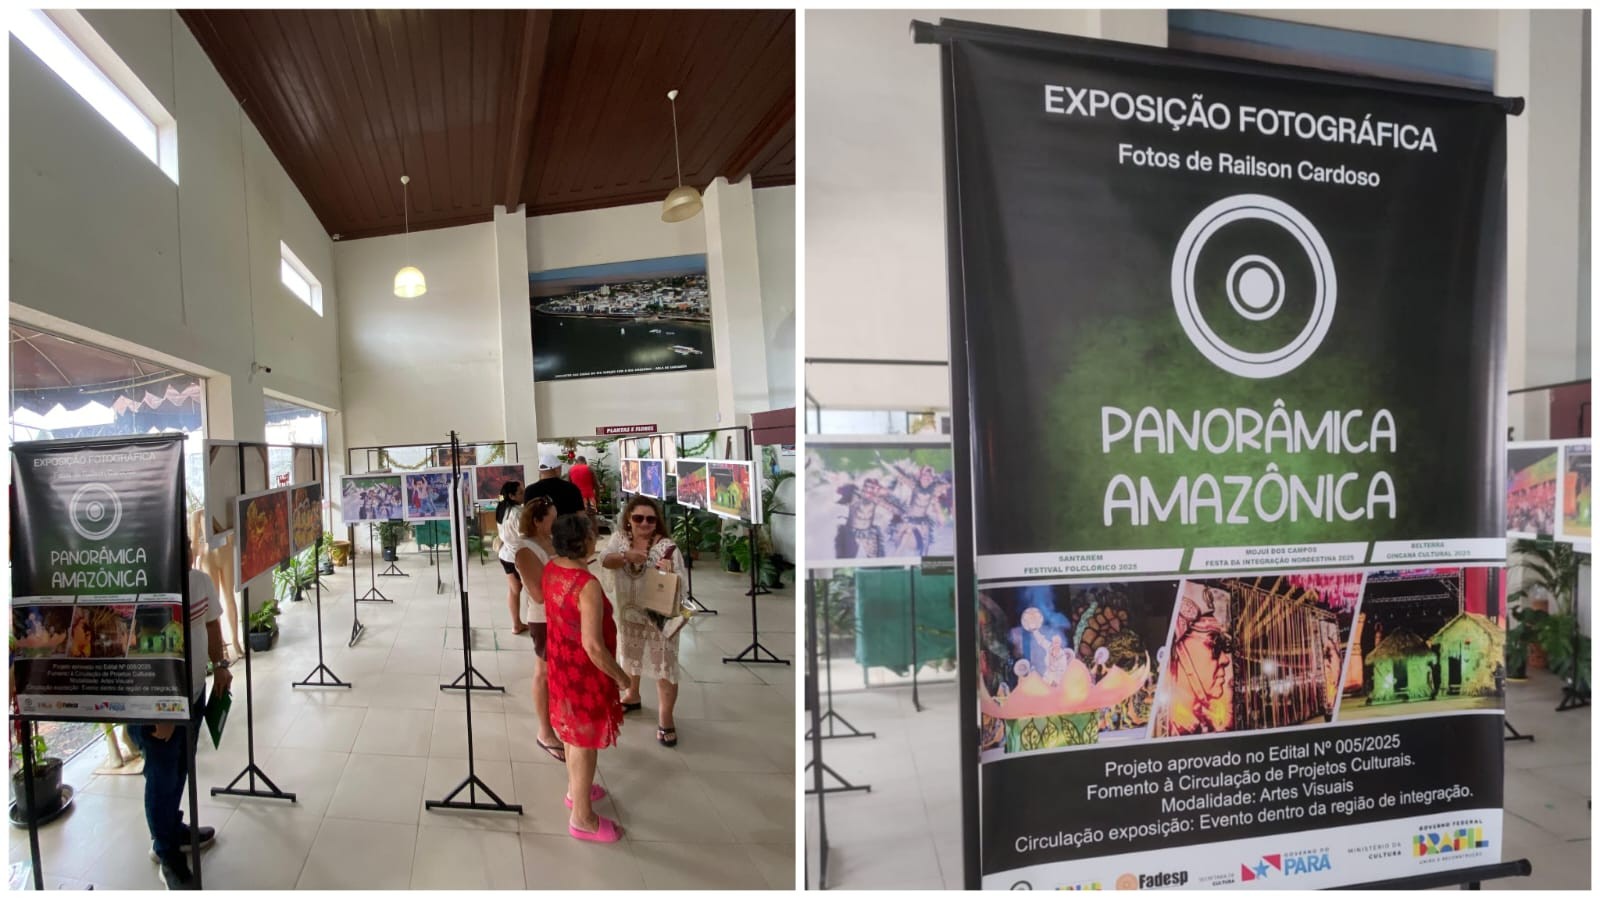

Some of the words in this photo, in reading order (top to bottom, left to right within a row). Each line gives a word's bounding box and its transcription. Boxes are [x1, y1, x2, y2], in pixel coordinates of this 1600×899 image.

[1044, 84, 1231, 132] EXPOSIÇÃO
[1239, 105, 1438, 153] FOTOGRÁFICA
[1118, 143, 1180, 169] Fotos
[1186, 150, 1213, 172] de
[1219, 153, 1293, 179] Railson
[1298, 160, 1381, 187] Cardoso
[1101, 398, 1397, 454] PANORÂMICA
[33, 455, 86, 468] EXPOSIÇÃO
[88, 451, 156, 464] FOTOGRÁFICA
[1103, 461, 1397, 526] AMAZÔNICA
[51, 546, 147, 566] PANORÂMICA
[1242, 556, 1289, 566] INTEGRAÇÃO
[1291, 555, 1336, 563] NORDESTINA
[1288, 546, 1317, 554] CAMPOS
[51, 567, 148, 588] AMAZÔNICA
[1024, 565, 1063, 574] FESTIVAL
[1119, 563, 1138, 571] 2025
[1105, 758, 1162, 779] Projeto
[1167, 751, 1241, 775] aprovado
[1246, 752, 1265, 766] no
[1269, 740, 1309, 761] Edital
[1314, 740, 1332, 756] Nº
[1335, 734, 1401, 754] 005/2025
[1087, 780, 1159, 800] Fomento
[1163, 777, 1174, 792] à
[1179, 769, 1261, 790] Circulação
[1265, 766, 1284, 781] de
[1288, 760, 1347, 780] Projetos
[1351, 752, 1416, 772] Culturais.
[1161, 790, 1257, 813] Modalidade:
[1260, 785, 1298, 802] Artes
[1302, 778, 1354, 797] Visuais
[1015, 828, 1104, 853] Circulação
[1108, 817, 1195, 842] exposição:
[1199, 811, 1253, 830] Evento
[1257, 802, 1304, 822] dentro
[1308, 801, 1327, 816] da
[1331, 795, 1375, 815] região
[1378, 793, 1396, 808] de
[1400, 783, 1474, 805] integração.
[1419, 823, 1450, 831] GOVERNO
[1452, 818, 1483, 827] FEDERAL
[1284, 848, 1317, 857] GOVERNO
[1412, 827, 1489, 856] BRASIL
[1284, 853, 1332, 876] PARÁ
[1369, 850, 1402, 860] CULTURA
[1138, 870, 1189, 889] Fadesp
